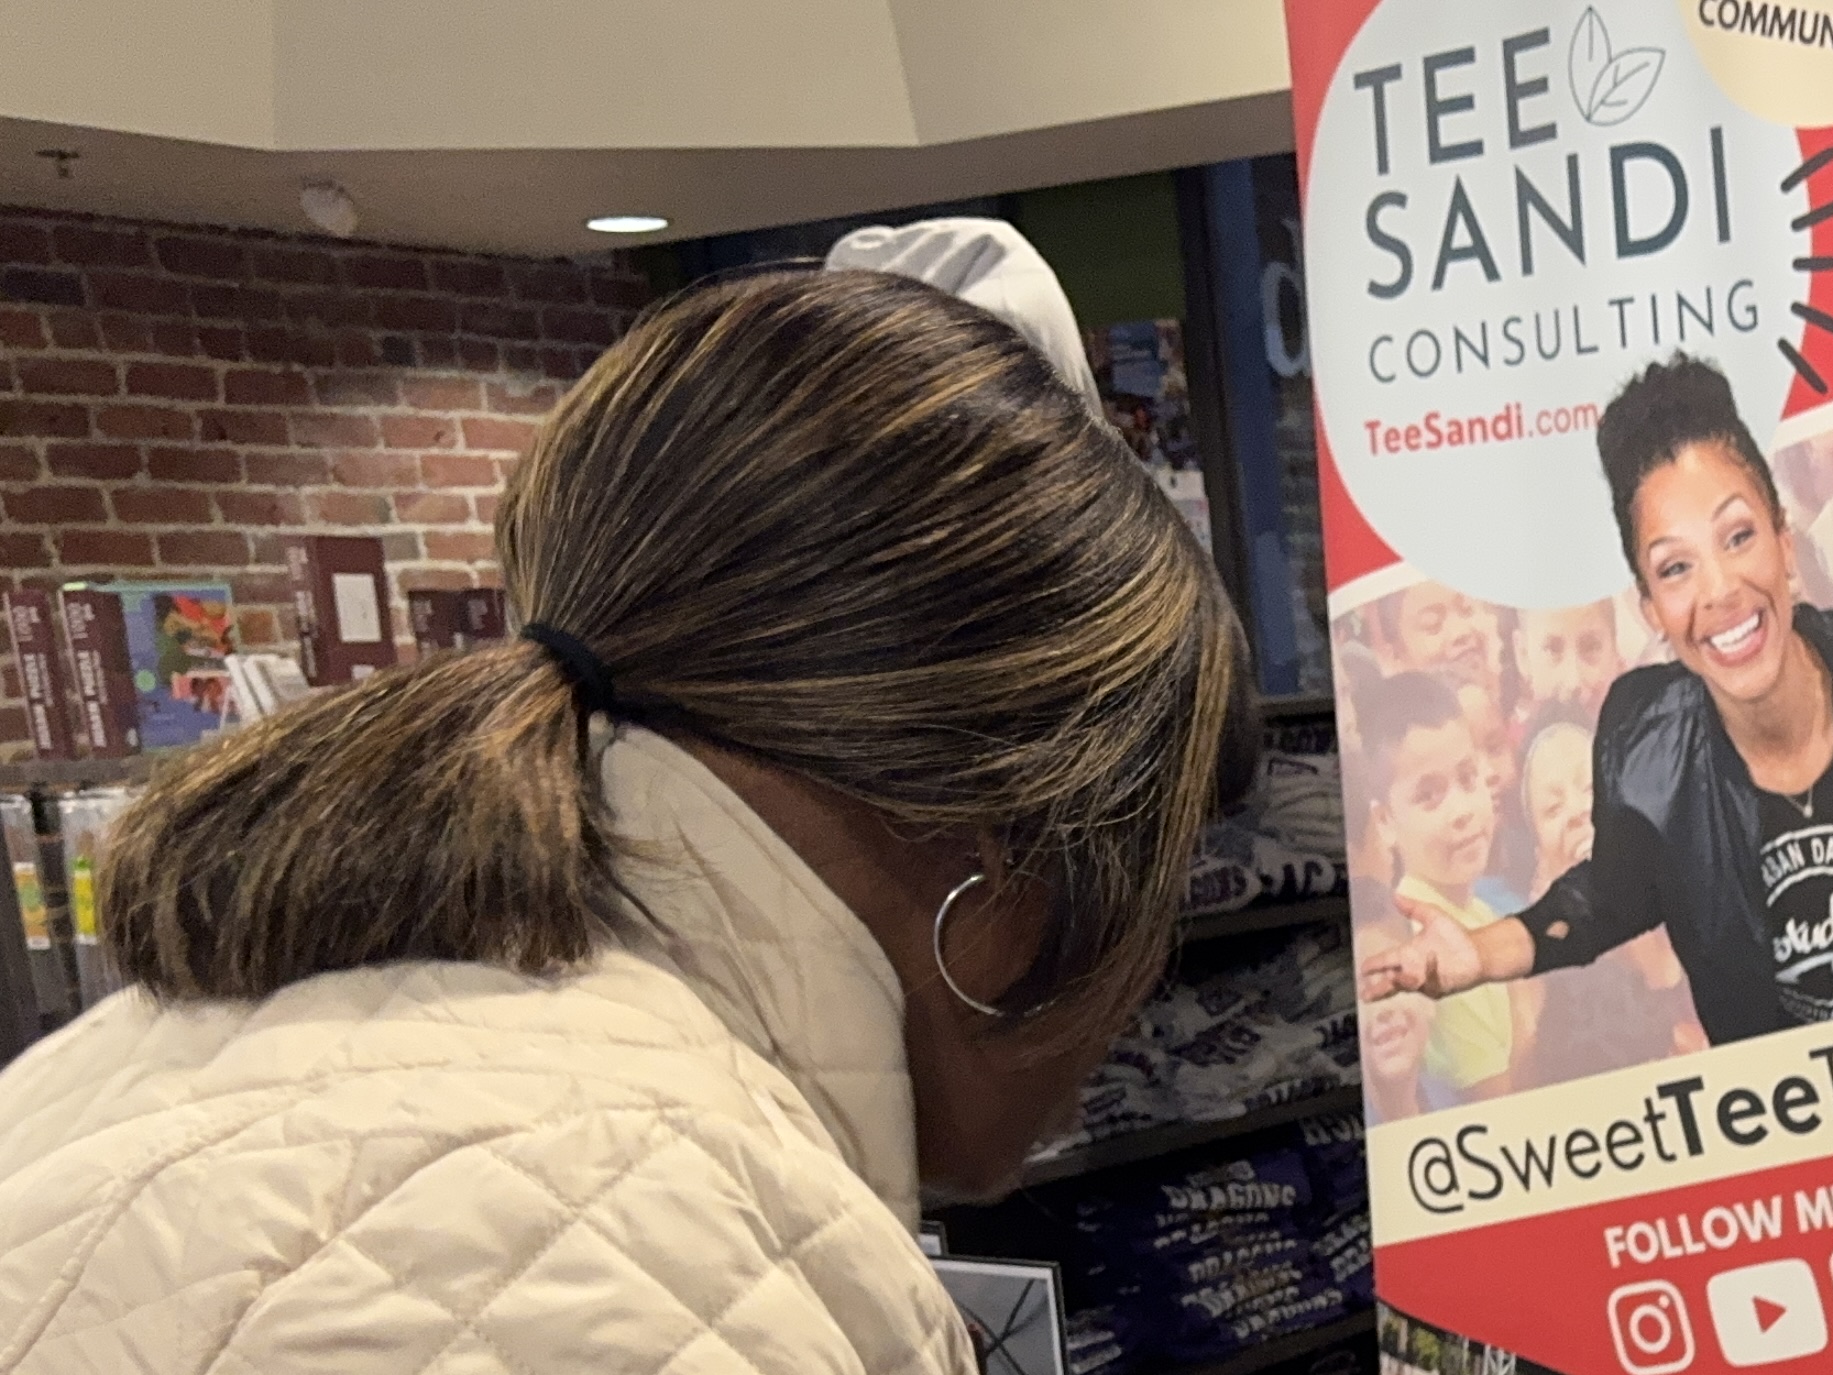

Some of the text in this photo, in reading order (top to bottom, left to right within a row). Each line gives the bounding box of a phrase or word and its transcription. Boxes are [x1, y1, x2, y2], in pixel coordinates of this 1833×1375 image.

[1352, 26, 1559, 176] TEE
[1363, 126, 1734, 301] SANDI
[1368, 279, 1760, 384] CONSULTING
[1364, 400, 1601, 456] TeeSandi.com
[1604, 1193, 1784, 1270] FOLLOW
